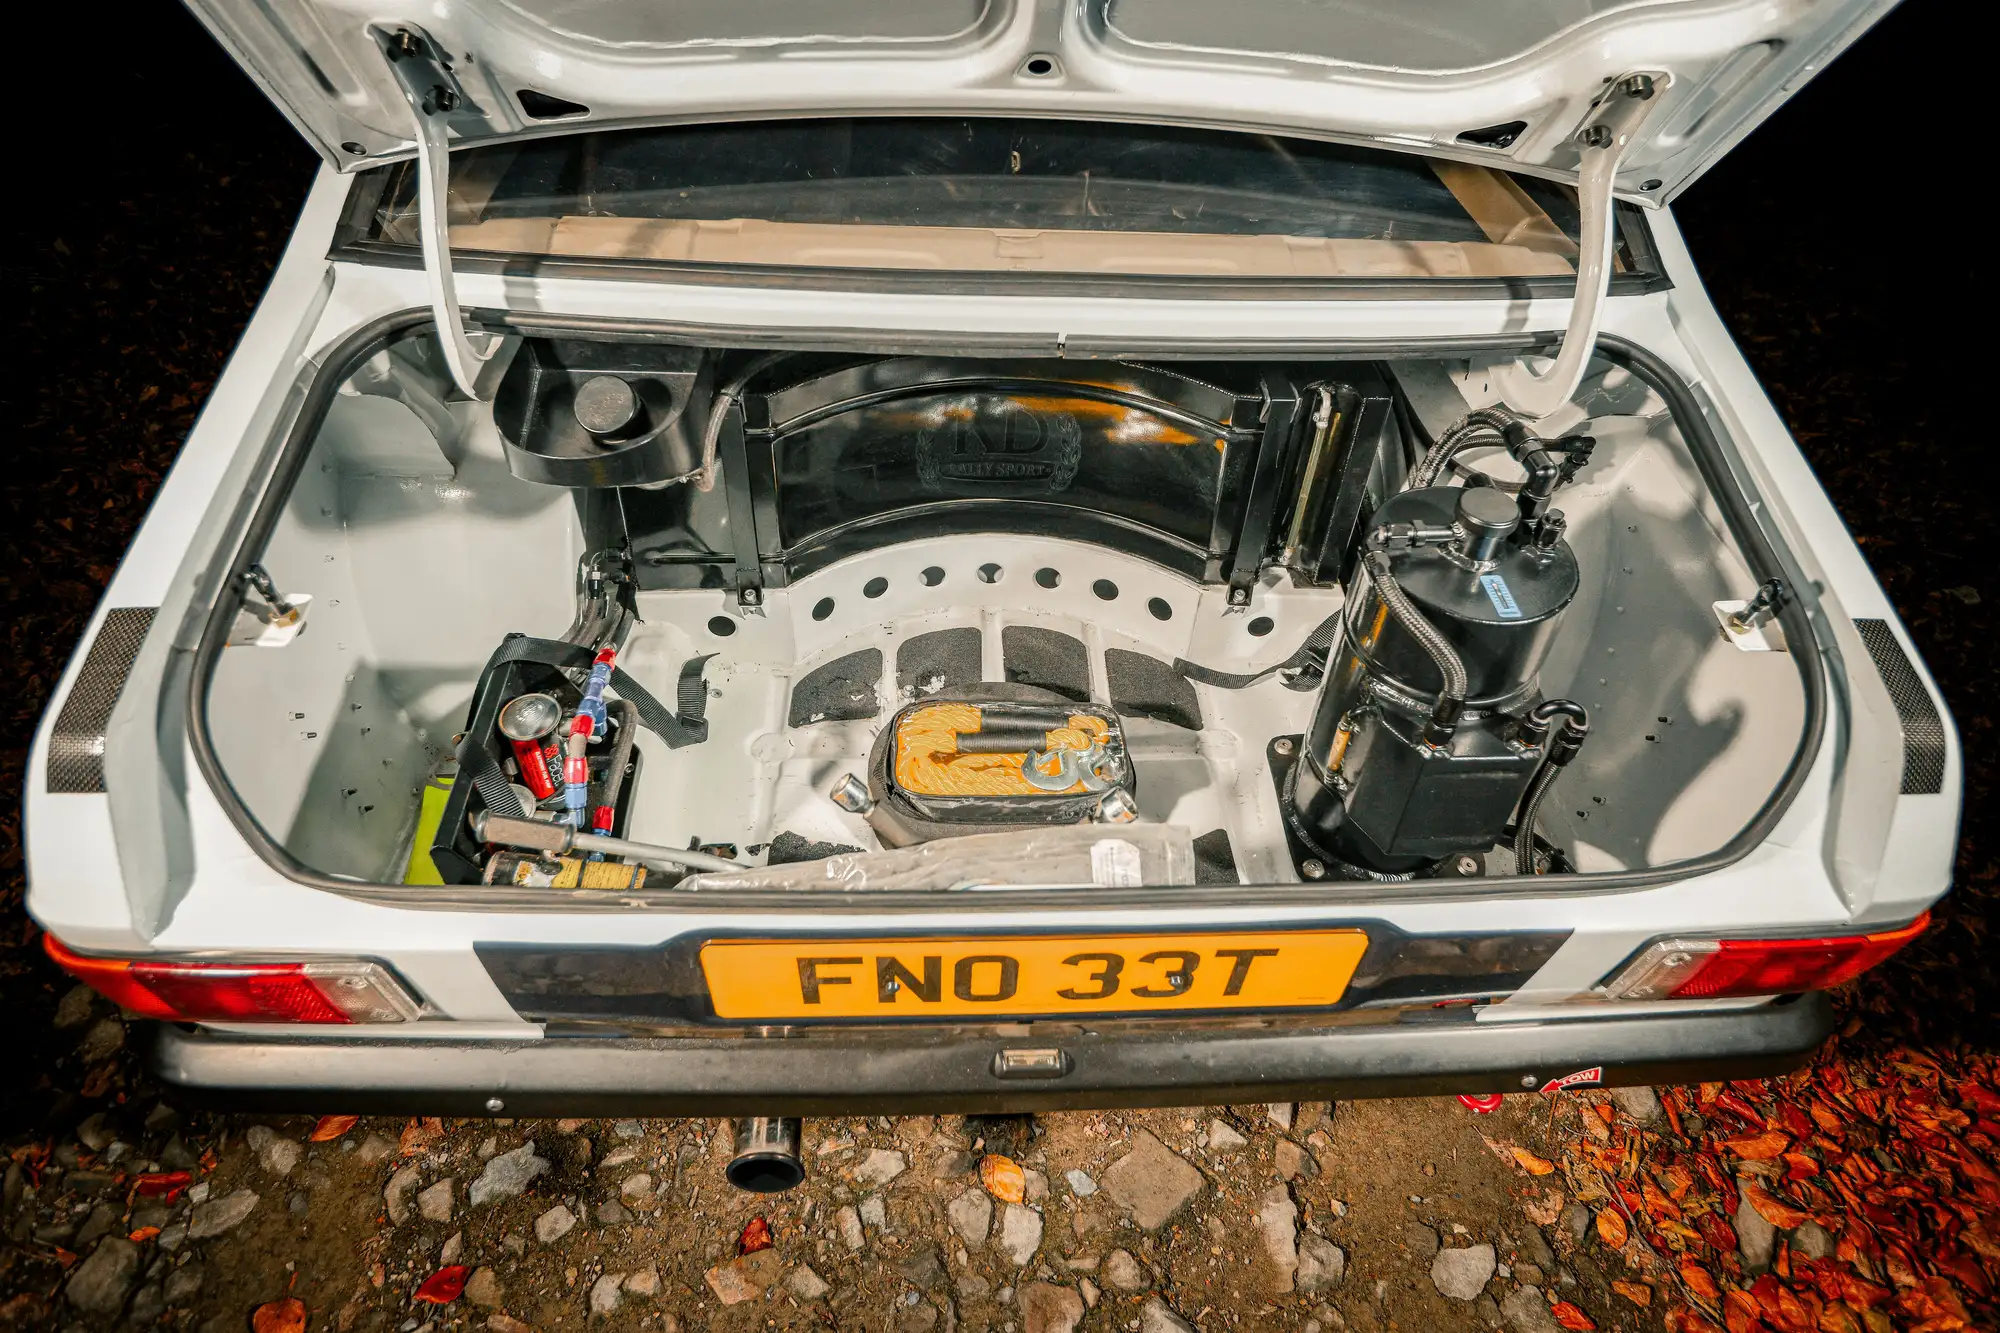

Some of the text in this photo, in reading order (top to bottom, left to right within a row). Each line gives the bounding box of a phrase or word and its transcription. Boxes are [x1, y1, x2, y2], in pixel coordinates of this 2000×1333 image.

[949, 462, 1046, 477] RALLY SPORT
[795, 948, 1279, 1005] FNO 33T
[1561, 1070, 1596, 1085] TOW
